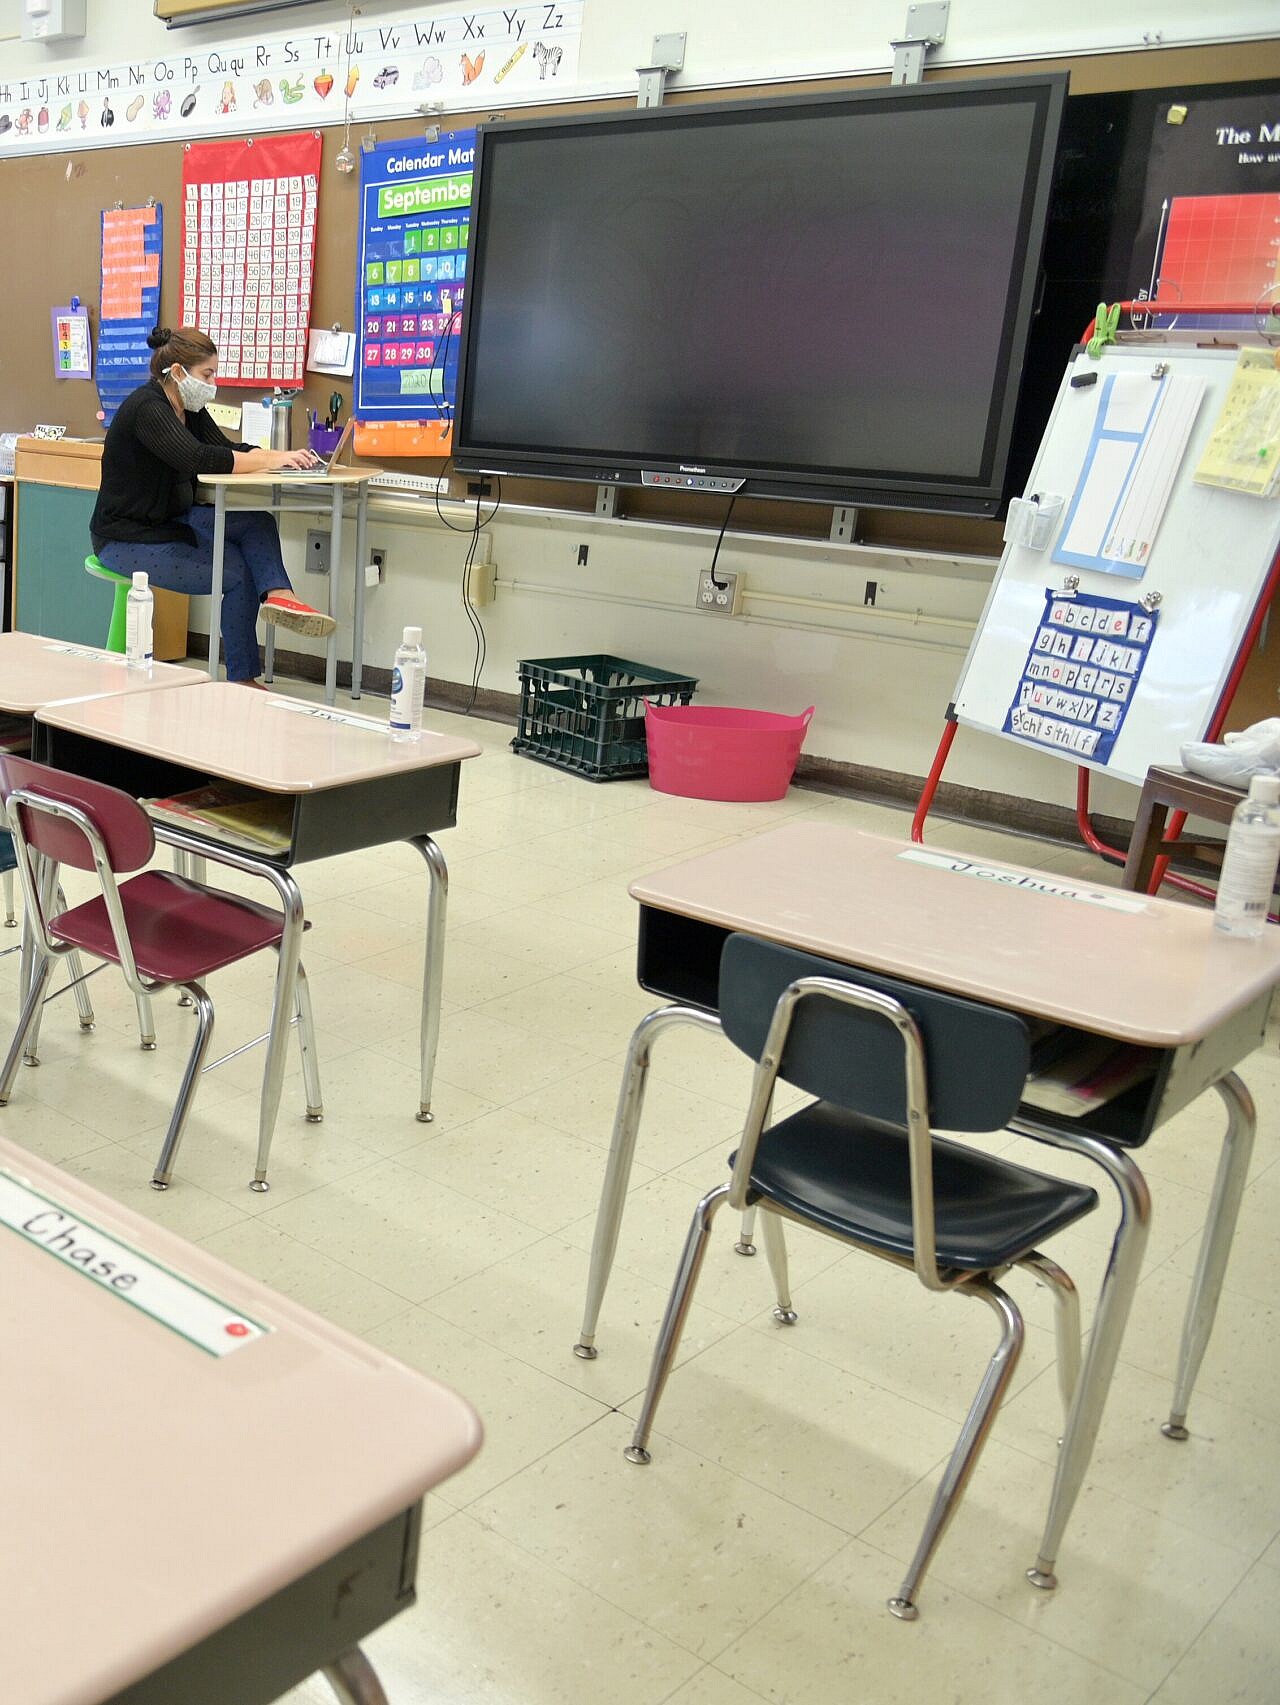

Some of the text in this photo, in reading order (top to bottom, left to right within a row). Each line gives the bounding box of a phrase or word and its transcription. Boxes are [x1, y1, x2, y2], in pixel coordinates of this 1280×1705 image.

[20, 82, 30, 100] Ii
[38, 79, 48, 104] Jj
[58, 76, 69, 95] Kk
[78, 74, 87, 92] Ll
[98, 70, 119, 90] Mm
[129, 66, 144, 85] Nn
[154, 62, 174, 81] Oo
[184, 58, 198, 83] Pp
[256, 46, 271, 66] Rr
[284, 42, 299, 62] Ss
[315, 37, 332, 58] Tt
[346, 33, 363, 54] Uu
[379, 27, 400, 49] Vv
[414, 22, 446, 45] Ww
[463, 16, 484, 40] Xx
[503, 9, 525, 41] Yy
[543, 4, 563, 29] Zz
[1216, 123, 1280, 145] The M
[386, 148, 475, 174] Calendar Mat
[1238, 152, 1264, 164] How
[190, 178, 314, 196] 1 4 5 6 7 8 9 10
[188, 197, 300, 211] 11 14 19
[384, 180, 472, 214] Septembe
[187, 214, 300, 228] 21 29
[188, 232, 285, 244] 31 38
[428, 234, 434, 246] 2
[446, 232, 452, 244] 3
[186, 249, 285, 260] 41 48
[186, 264, 298, 276] 51 56 59
[372, 262, 451, 279] 6 7 8 9 10
[185, 282, 257, 292] 61 66
[245, 300, 255, 308] 76
[371, 289, 449, 306] 13 14 15 16 17
[185, 314, 269, 325] 81 87
[367, 322, 379, 332] 20
[386, 322, 396, 332] 21
[403, 320, 415, 331] 22
[422, 320, 434, 330] 23
[258, 332, 268, 342] 97
[367, 347, 431, 361] 27 28 29 30
[256, 367, 267, 375] 117
[1054, 607, 1146, 638] a b c d e f
[1040, 634, 1132, 669] g h i j k l
[1029, 662, 1125, 694] m n o p q r s
[1023, 686, 1112, 722] t u v w x y z
[950, 862, 1078, 898] Joshua
[22, 1210, 140, 1292] Chase
